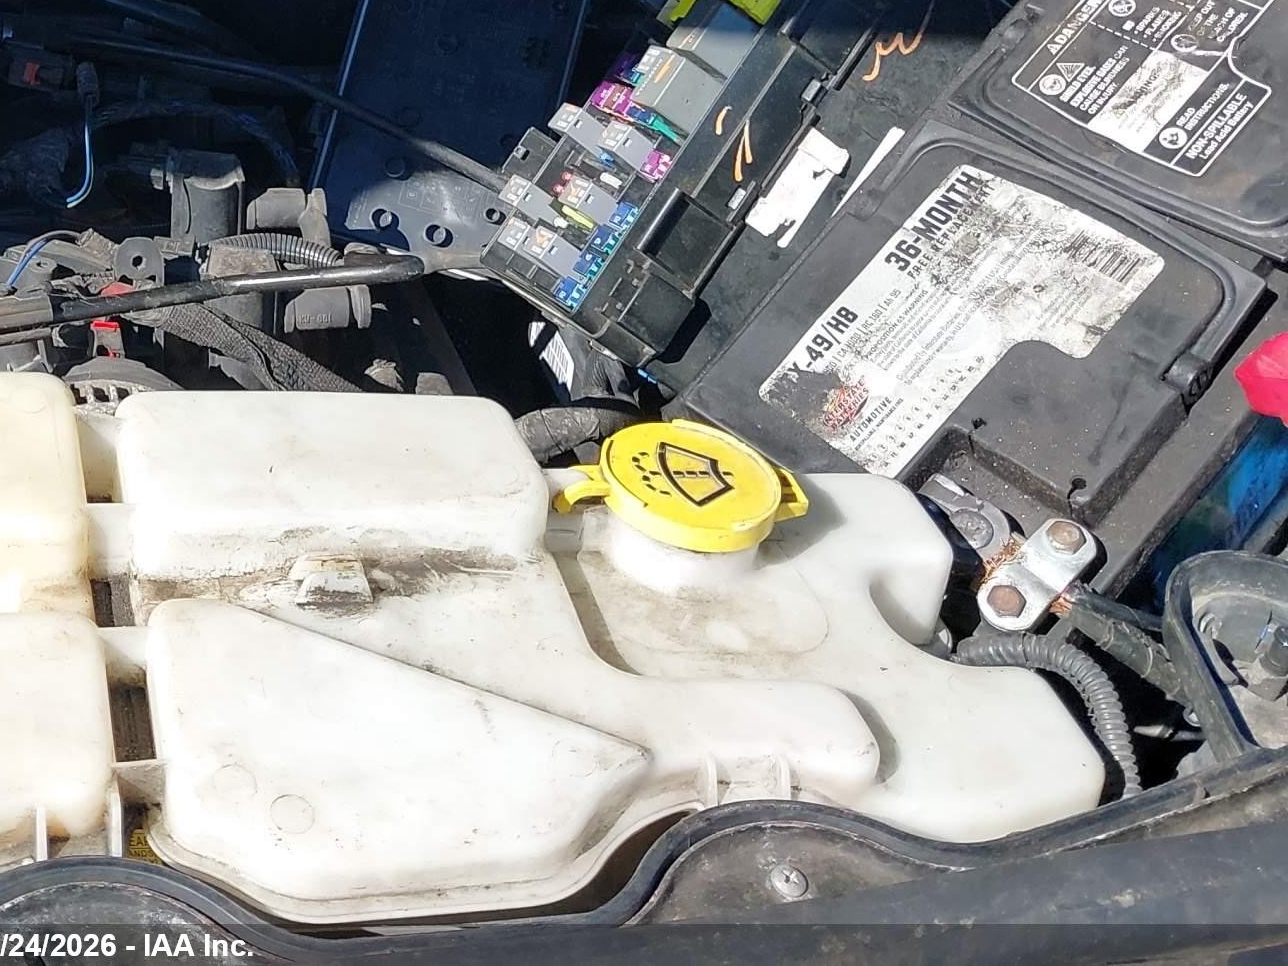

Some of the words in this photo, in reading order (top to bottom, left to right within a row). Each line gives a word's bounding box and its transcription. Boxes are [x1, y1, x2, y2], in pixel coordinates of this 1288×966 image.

[1200, 0, 1215, 14] OUT
[1112, 44, 1128, 59] CAN
[1079, 88, 1101, 111] CAUSE
[1096, 56, 1130, 91] BLINDNESS
[1183, 81, 1230, 130] INSTRUCTIONS.
[1086, 102, 1100, 114] OR
[1175, 106, 1196, 126] READ
[1184, 92, 1247, 159] NON-SPILLABLE
[1198, 140, 1218, 158] Lead
[1214, 124, 1232, 141] Acid
[1227, 100, 1253, 126] Battery
[883, 169, 984, 272] 36-MONTH
[907, 252, 933, 279] FREE
[902, 289, 928, 315] WARNING
[821, 377, 865, 426] INTERSTATE
[830, 387, 869, 430] BATTERIES
[848, 396, 892, 442] AUTOMOTIVE
